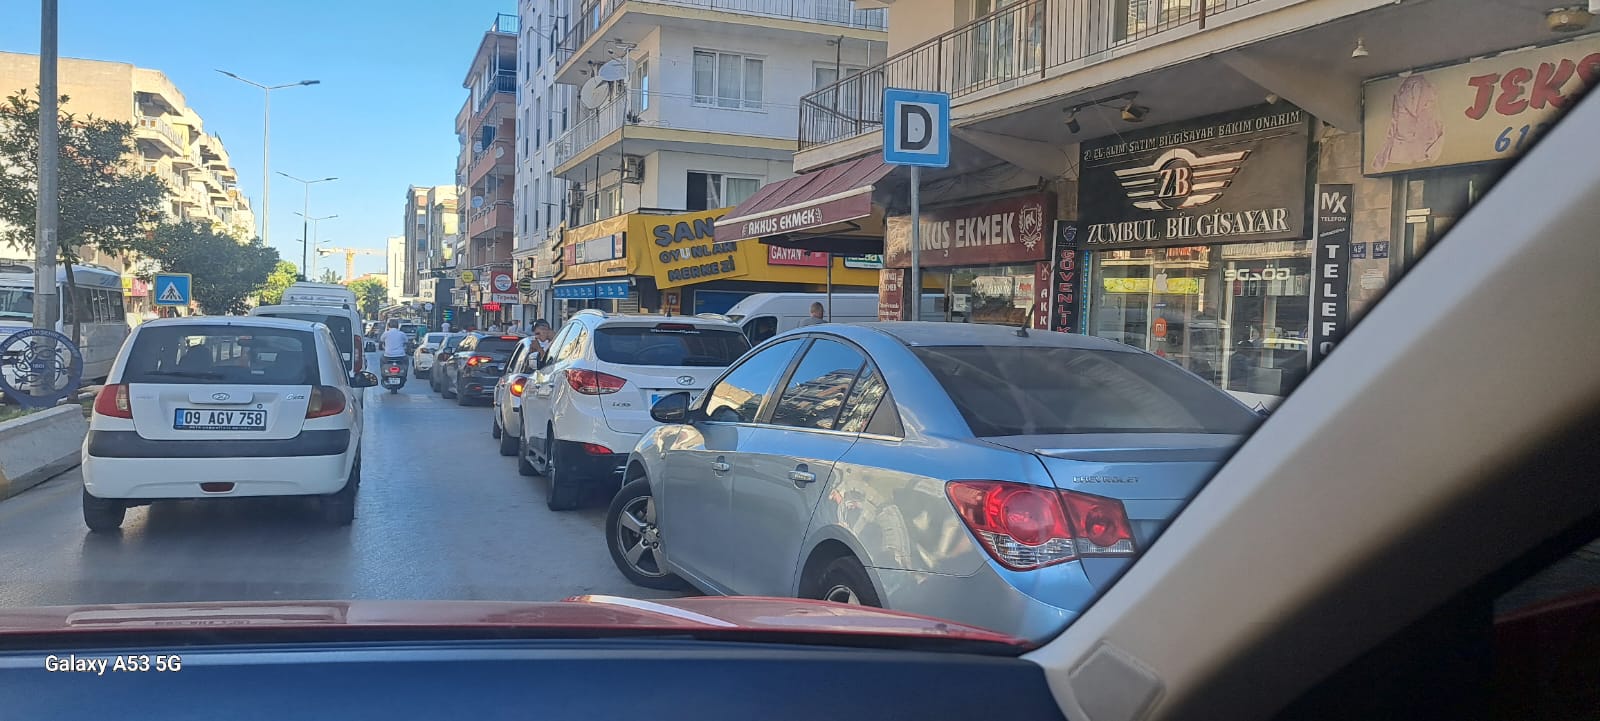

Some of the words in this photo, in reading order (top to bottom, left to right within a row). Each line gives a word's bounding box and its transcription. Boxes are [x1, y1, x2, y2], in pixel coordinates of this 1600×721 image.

[901, 104, 932, 150] D
[1129, 139, 1157, 152] SATIM
[1218, 120, 1252, 136] BAKIM
[1256, 111, 1300, 130] ONARIM
[1158, 168, 1191, 198] ZB
[1321, 192, 1347, 214] MX
[653, 213, 725, 247] SAN
[780, 208, 815, 230] EKMEK
[902, 220, 950, 257] AKUŞ
[955, 211, 1016, 248] EKMEK
[1166, 208, 1291, 240] BİLGİSAYAR
[771, 246, 801, 260] GANYAN
[185, 411, 200, 424] 09
[208, 411, 233, 425] AGV
[239, 412, 262, 425] 758
[1072, 475, 1138, 484] CHEVROLET
